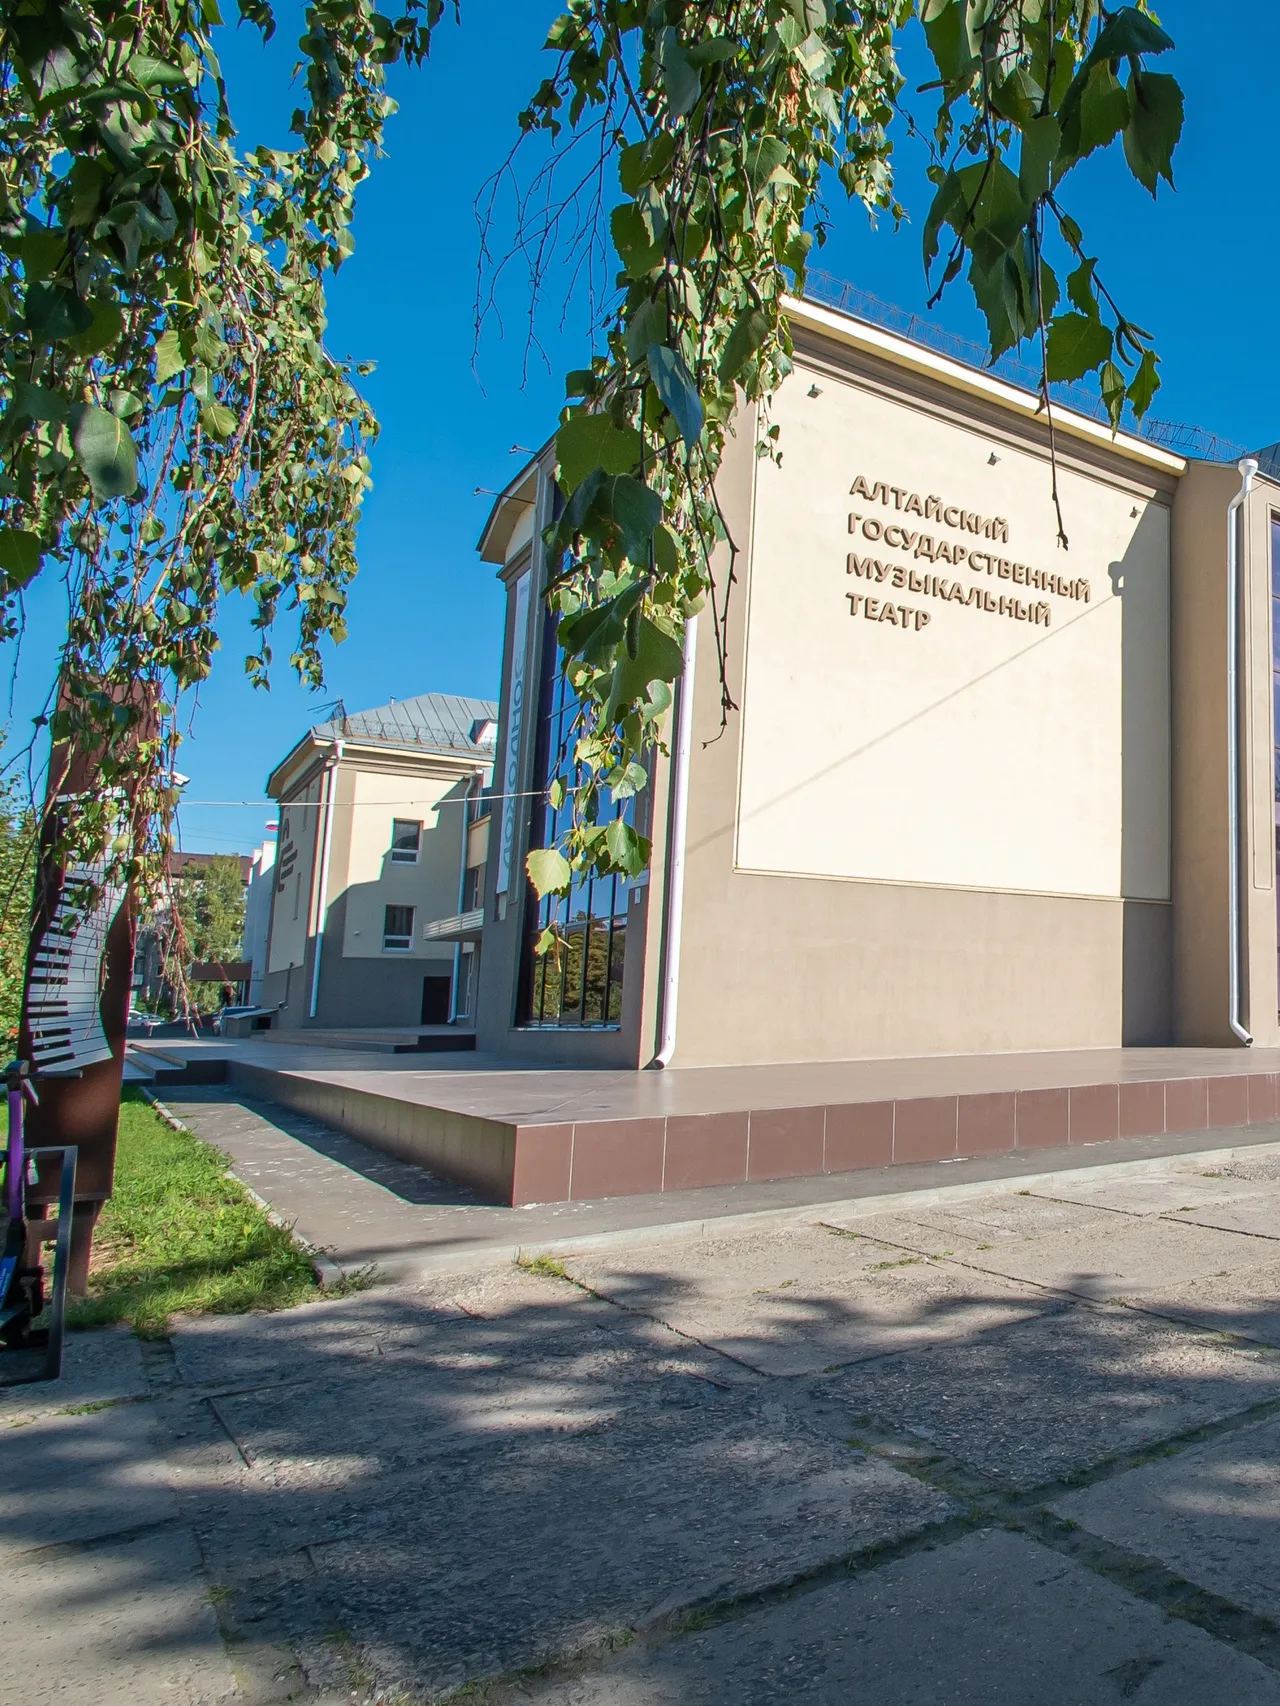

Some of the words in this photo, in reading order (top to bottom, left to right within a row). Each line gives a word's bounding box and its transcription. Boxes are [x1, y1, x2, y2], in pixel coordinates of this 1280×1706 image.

[849, 475, 1009, 543] АЛТАЙСКИЙ
[846, 552, 1052, 627] МУЗЫКАЛЬНЫЙ
[847, 512, 1092, 603] ГОСУДАРСТВЕННЫЙ
[845, 591, 931, 631] ТЕАТР
